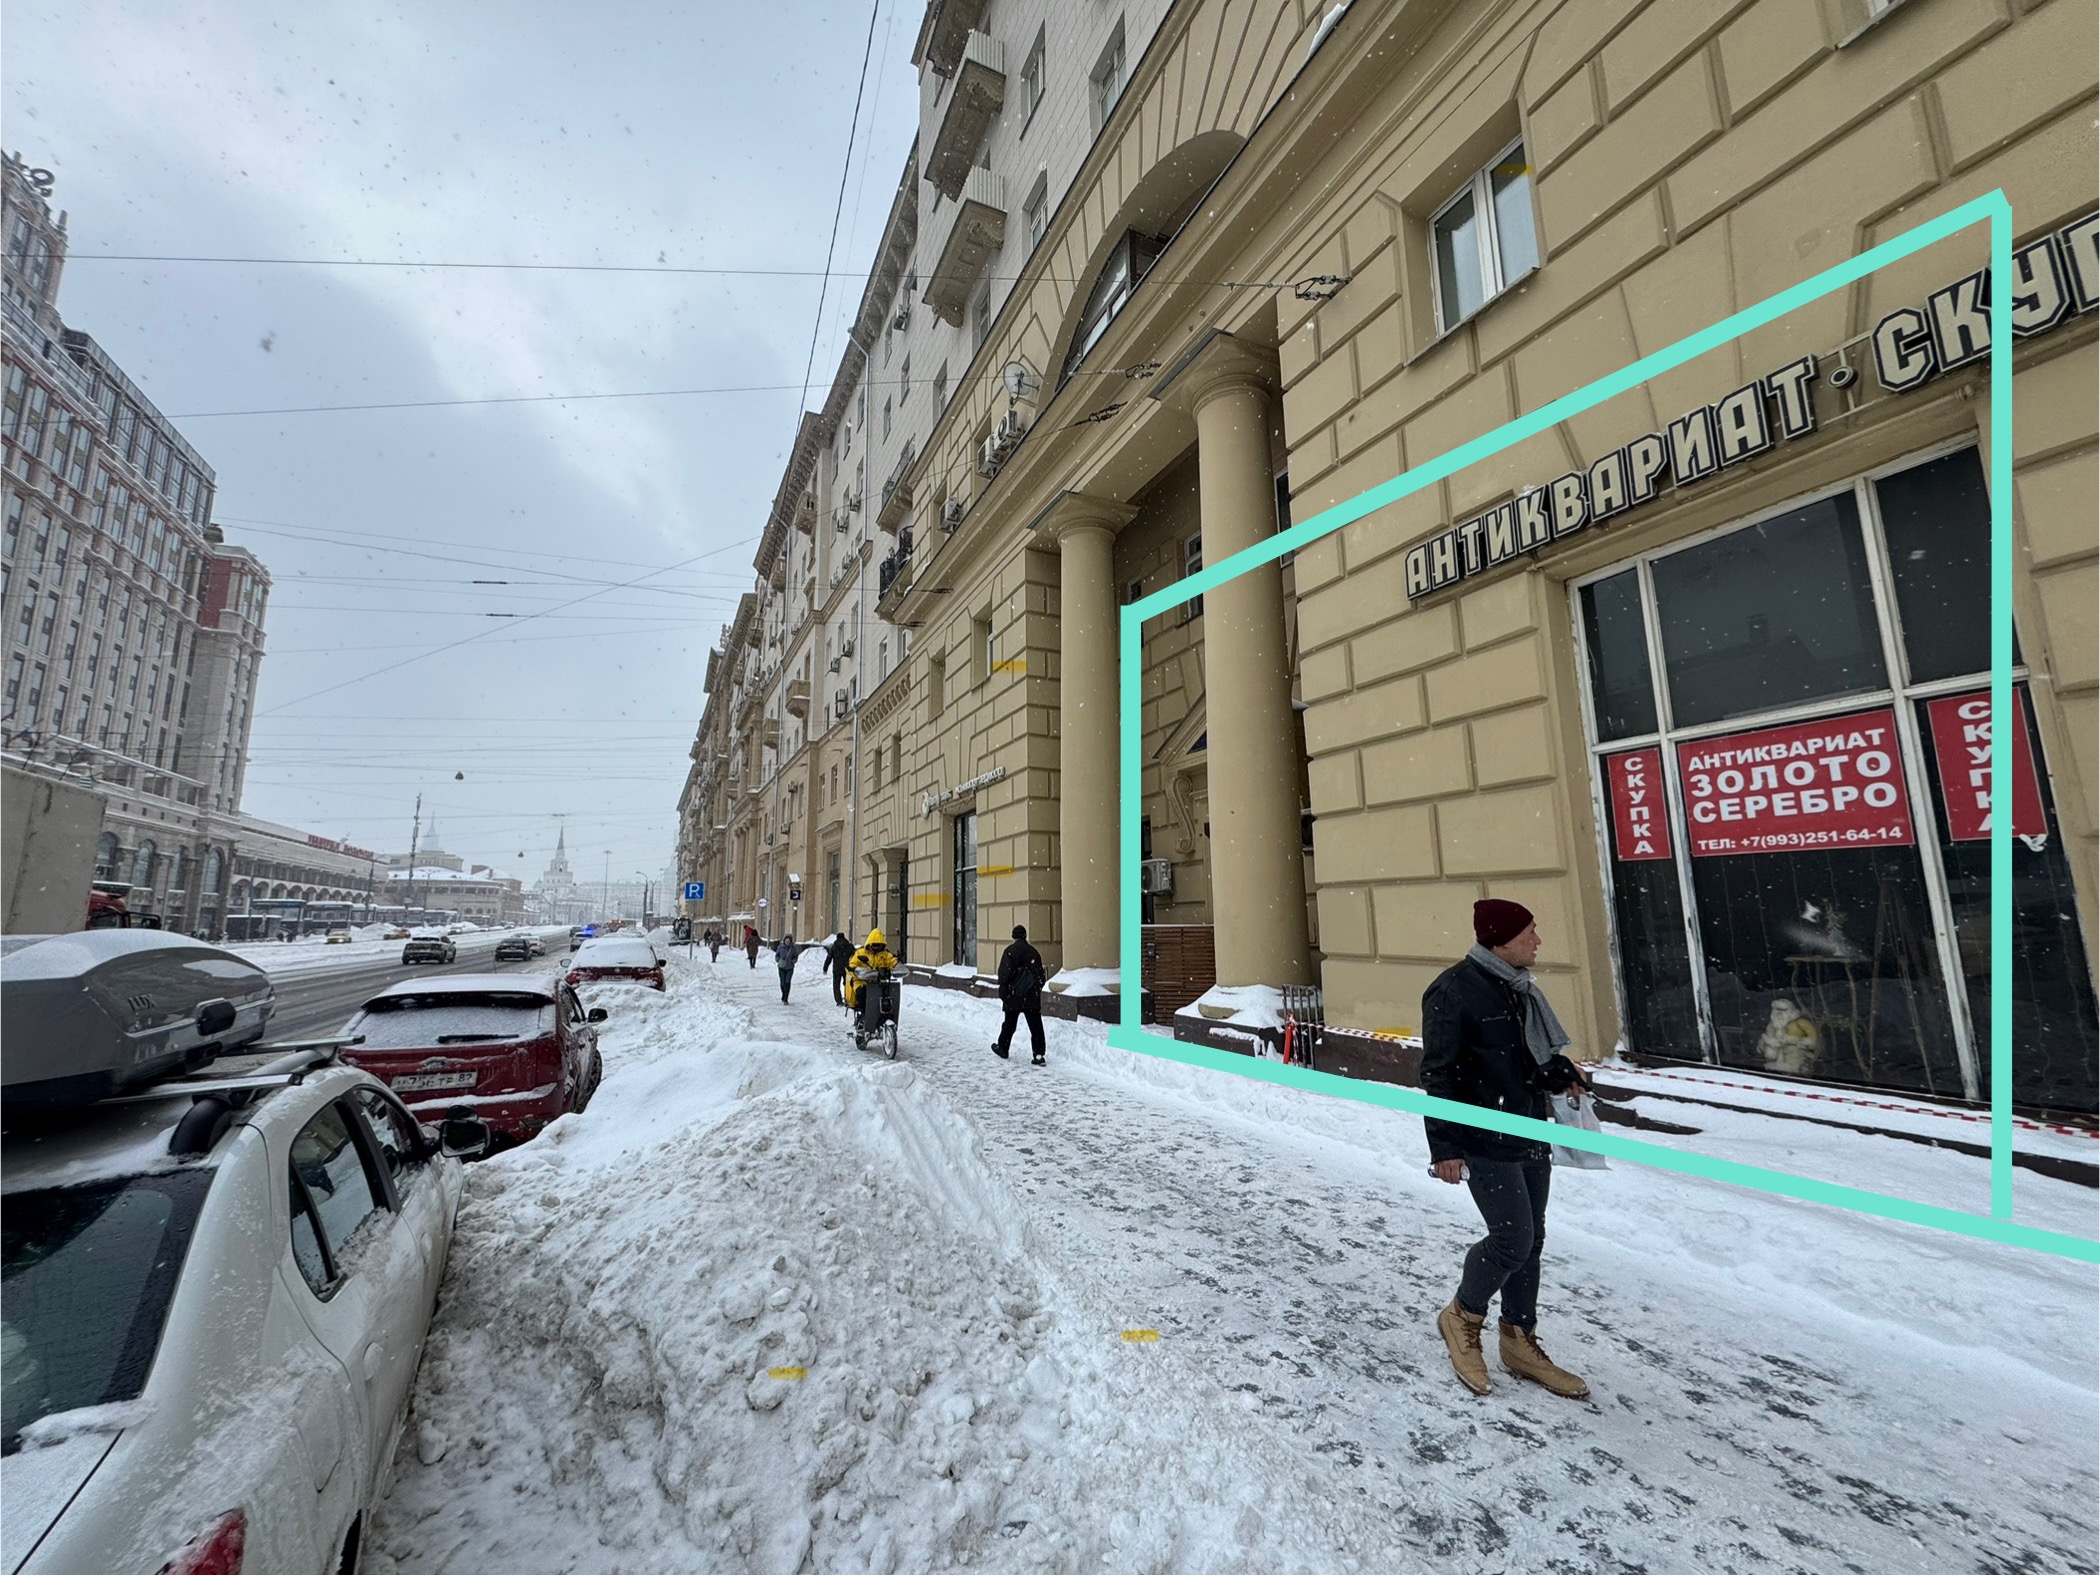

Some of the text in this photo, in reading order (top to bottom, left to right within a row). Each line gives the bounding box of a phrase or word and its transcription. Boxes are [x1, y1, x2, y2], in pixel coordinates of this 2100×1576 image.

[1405, 353, 1819, 600] АНТИКВАРИАТ
[1688, 728, 1885, 771] АНТИКВАРИАТ
[1689, 751, 1891, 797] ЗОЛОТО
[1624, 757, 1655, 854] СКУПКА
[1693, 782, 1897, 823] СЕРЕБРО
[1698, 826, 1902, 850] ТЕЛ: +7(993)251-64-14
